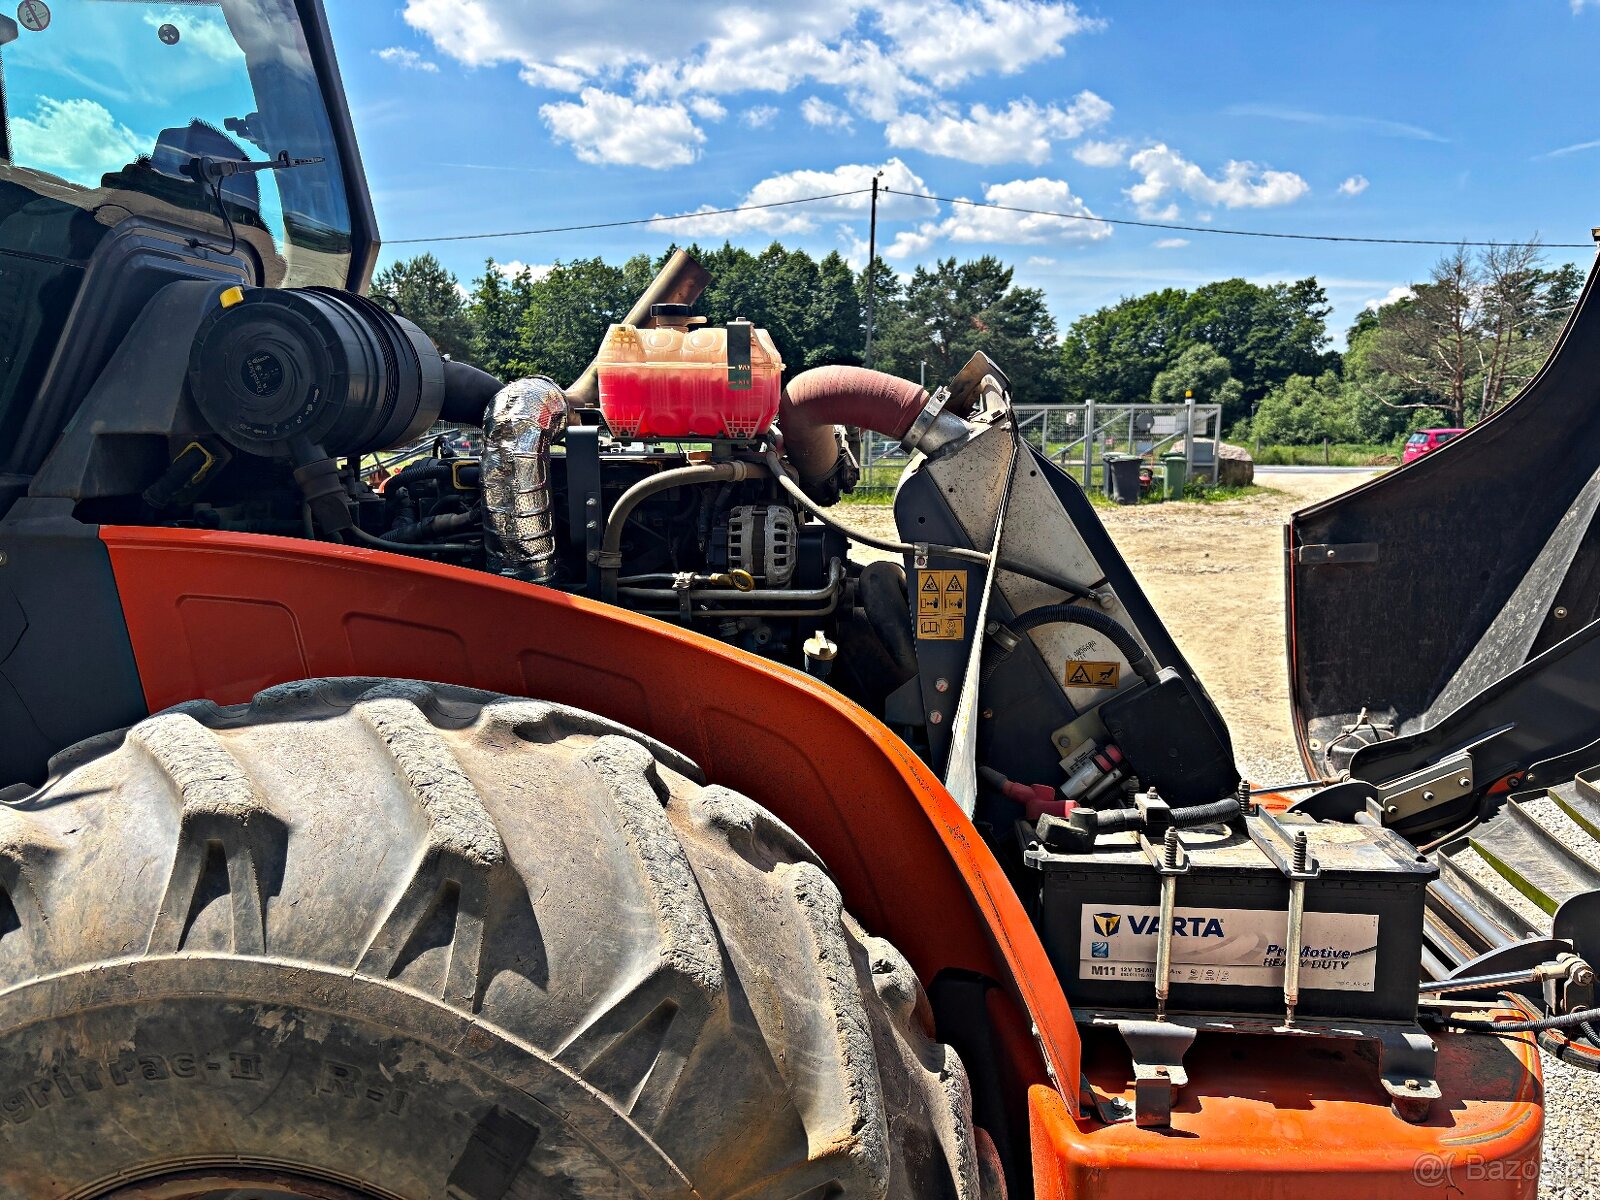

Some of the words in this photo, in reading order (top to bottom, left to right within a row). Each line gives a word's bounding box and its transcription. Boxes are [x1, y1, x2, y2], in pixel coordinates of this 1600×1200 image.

[1127, 915, 1224, 938] VARTA
[1311, 959, 1349, 970] DUTY
[1091, 965, 1116, 976] M11
